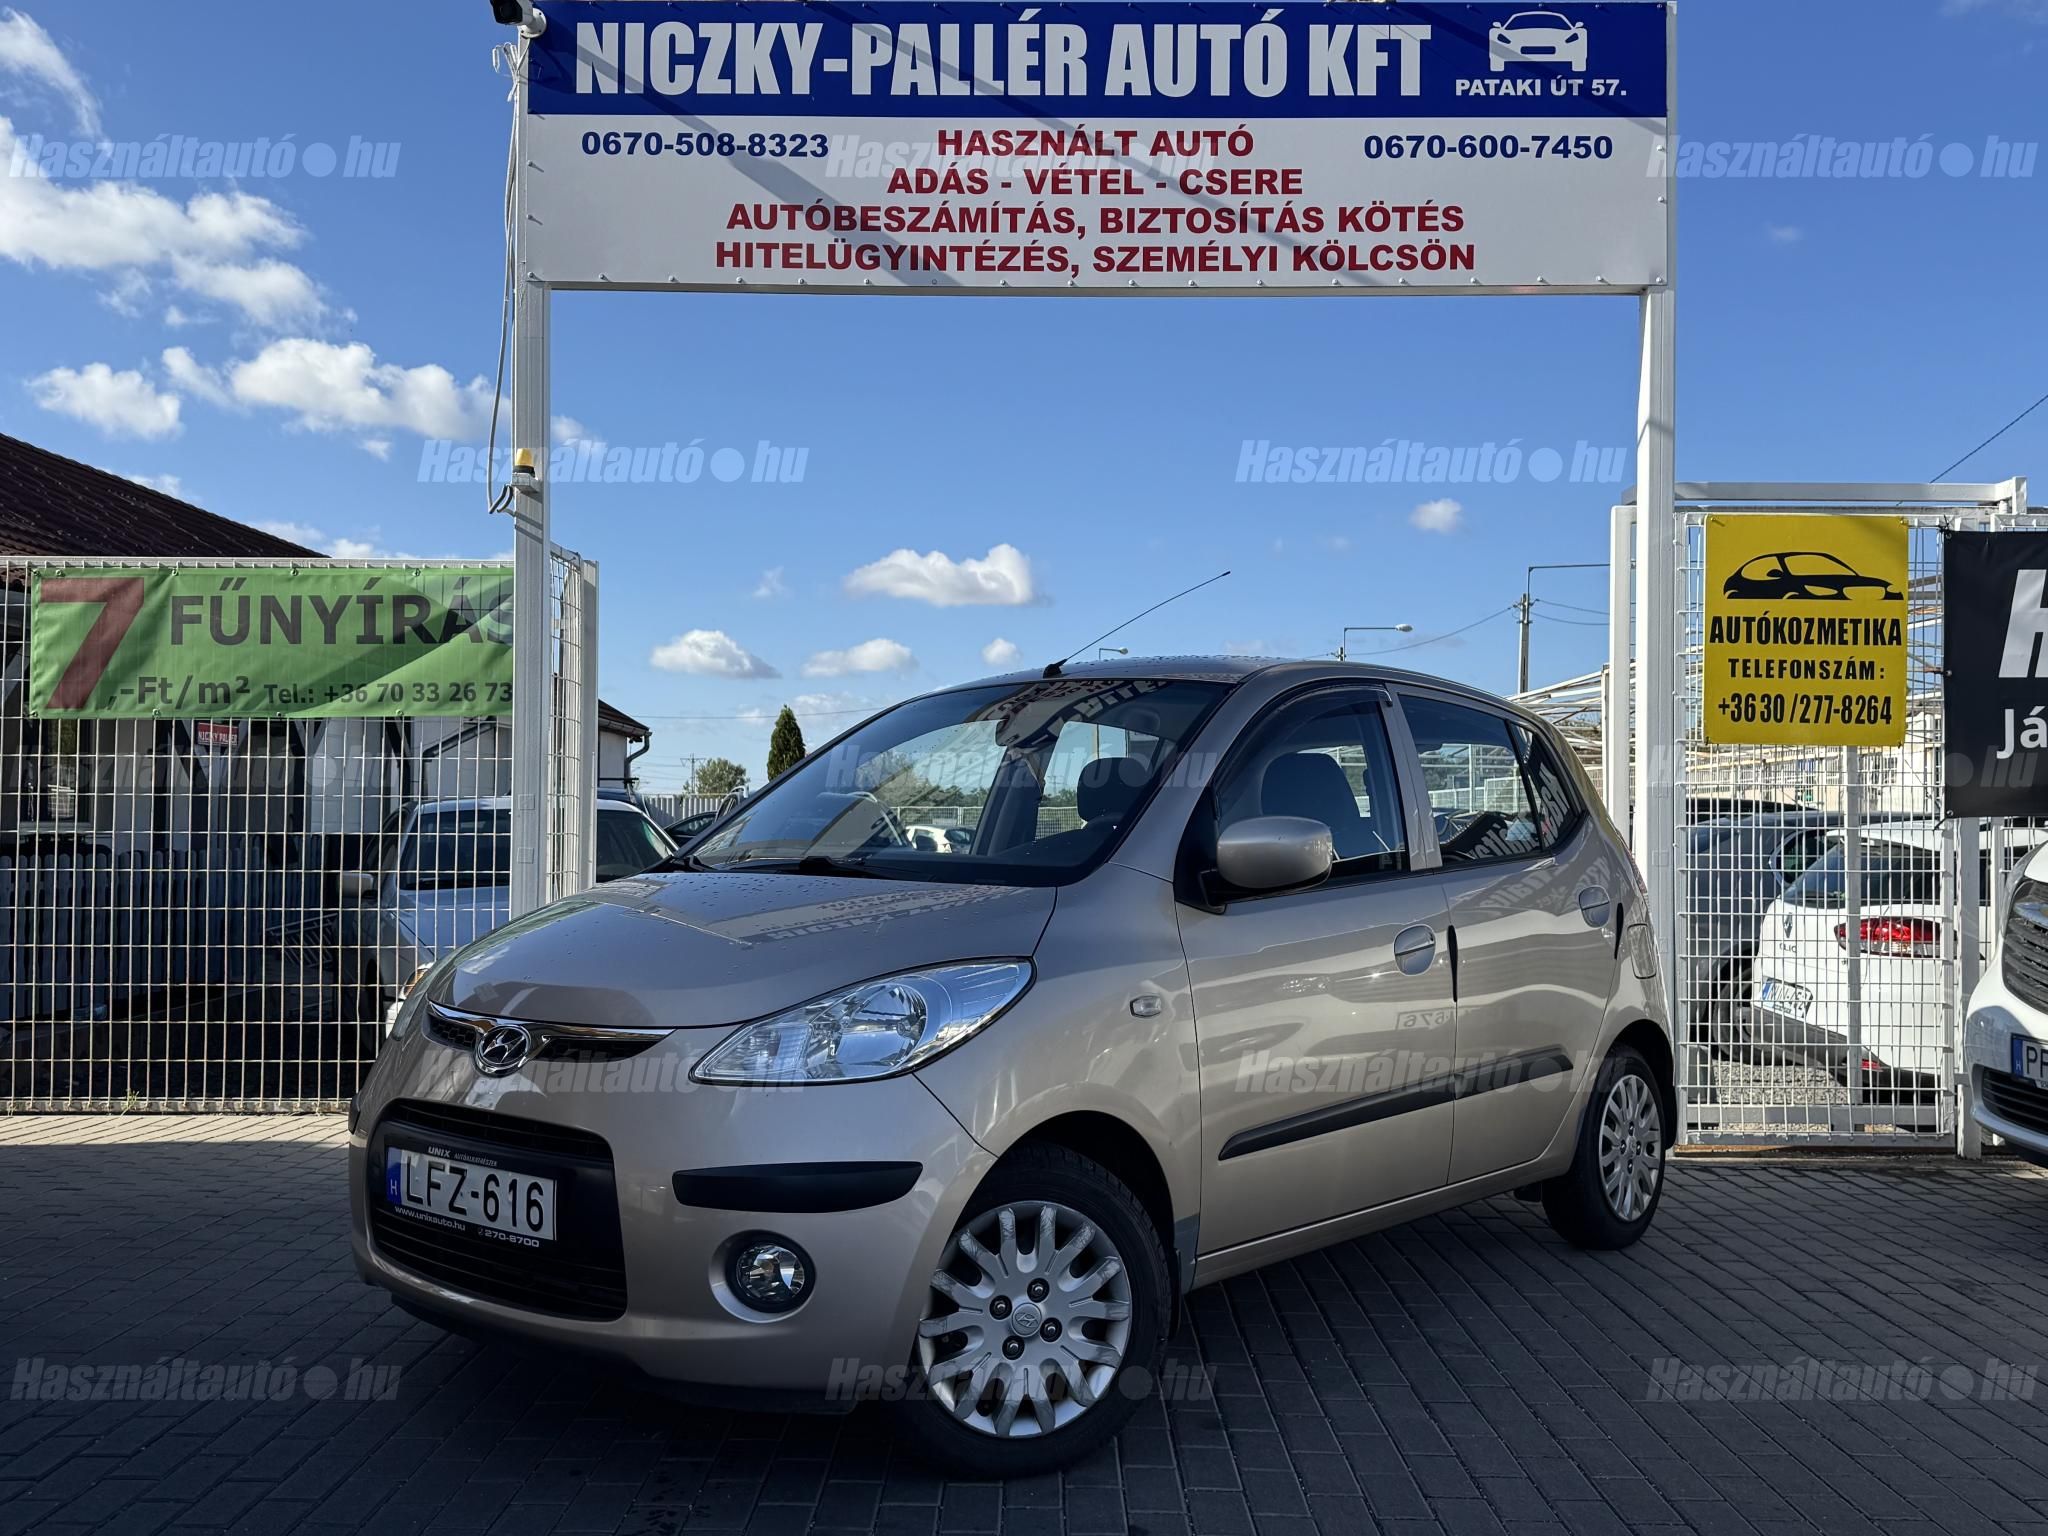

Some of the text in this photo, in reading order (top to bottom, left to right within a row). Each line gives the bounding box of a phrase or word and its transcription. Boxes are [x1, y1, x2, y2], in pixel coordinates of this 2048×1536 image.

[575, 8, 1432, 98] NICZKY-PALLÉR AUTÓ KFT
[1455, 73, 1628, 97] PATAKI ÚT 57.
[581, 130, 829, 158] 0670-508-8323
[937, 123, 1255, 157] HASZNÁLT AUTÓ
[1363, 134, 1614, 159] 0670-600-7450
[887, 161, 990, 195] ADÁS
[1023, 161, 1144, 195] VÉTEL
[1178, 168, 1304, 196] CSERE
[726, 198, 1465, 241] AUTÓBESZÁMÍTÁS, BIZTOSÍTÁS KÖTÉS
[715, 238, 1476, 278] HITELÜGYINTÉZÉS, SZEMÉLYI KÖLCSÖN
[1709, 611, 1902, 646] AUTÓKOZMETIKA
[324, 683, 368, 703] +36
[377, 682, 404, 703] 70
[412, 682, 440, 703] 33
[449, 682, 477, 703] 26
[428, 1146, 451, 1158] UNIX
[390, 1155, 545, 1233] H LFZ-616
[394, 1205, 540, 1248] www.unixauto.hu 270-8700
